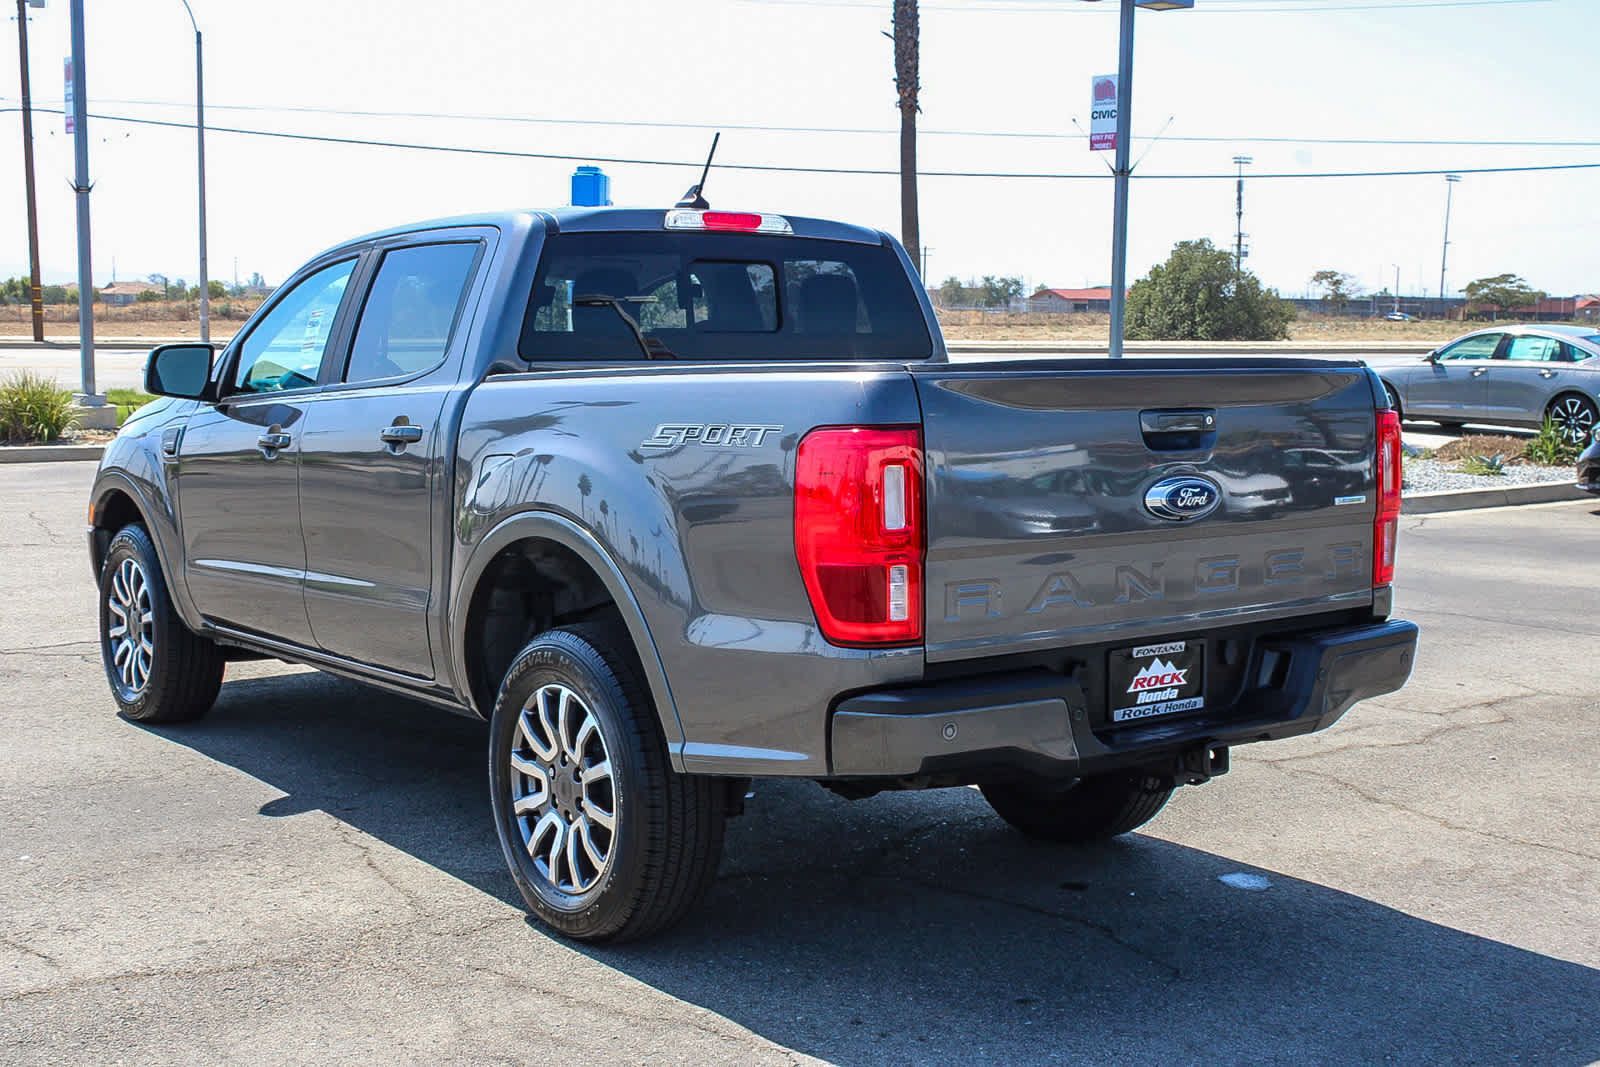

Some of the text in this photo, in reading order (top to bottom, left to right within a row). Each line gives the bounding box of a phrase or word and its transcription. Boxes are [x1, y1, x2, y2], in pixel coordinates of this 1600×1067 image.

[1091, 109, 1118, 120] CIVIC
[640, 424, 784, 450] SPORT
[1177, 487, 1208, 507] Ford
[944, 541, 1363, 622] RANGER
[1134, 643, 1184, 657] FONTANA
[1132, 671, 1184, 690] ROCK
[1136, 688, 1179, 705] Honda
[1120, 699, 1198, 719] Rock Honda
